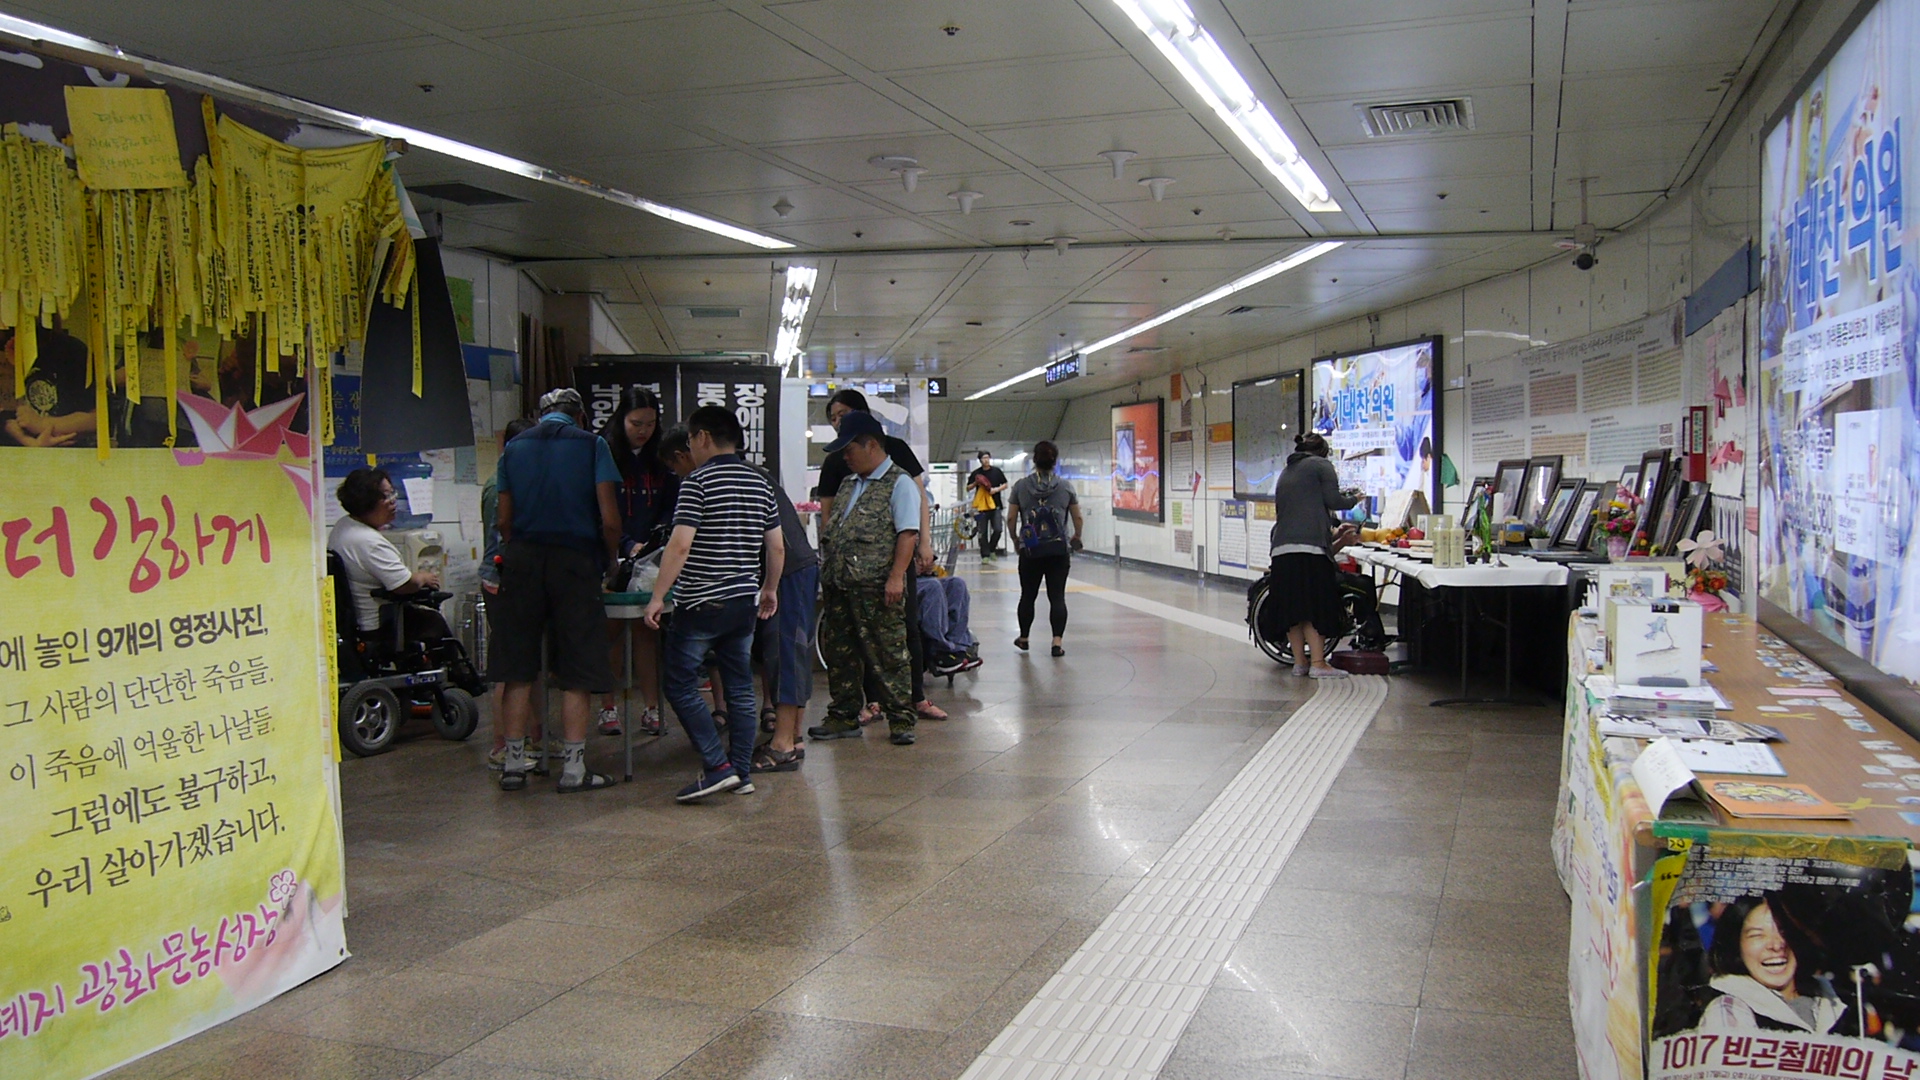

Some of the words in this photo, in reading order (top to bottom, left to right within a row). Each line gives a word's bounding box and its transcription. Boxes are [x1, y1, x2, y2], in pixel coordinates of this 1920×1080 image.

[1784, 161, 1845, 315] 기대찬
[1847, 115, 1904, 281] 의원
[1332, 386, 1369, 427] 기대찬
[1371, 384, 1396, 423] 의원
[2, 506, 76, 579] 더
[90, 495, 272, 594] 강하게
[34, 627, 90, 670] 놓인
[97, 619, 164, 658] 9개의
[169, 604, 270, 648] 영정사진,
[2, 700, 35, 729] 그
[40, 682, 118, 726] 사람의
[125, 667, 198, 710] 단단한
[10, 752, 37, 790] 이
[44, 738, 129, 782] 죽음에
[133, 719, 205, 761] 억울한
[50, 784, 171, 839] 그럼에도
[174, 757, 278, 811] 불구하고,
[27, 857, 94, 909] 우리
[99, 802, 286, 889] 살아가겠습니다.
[75, 905, 279, 1011] 광화문농성장
[1664, 1034, 1718, 1070] 1017
[1722, 1036, 1875, 1080] 빈곤철폐의
[1882, 1055, 1919, 1080] 날
